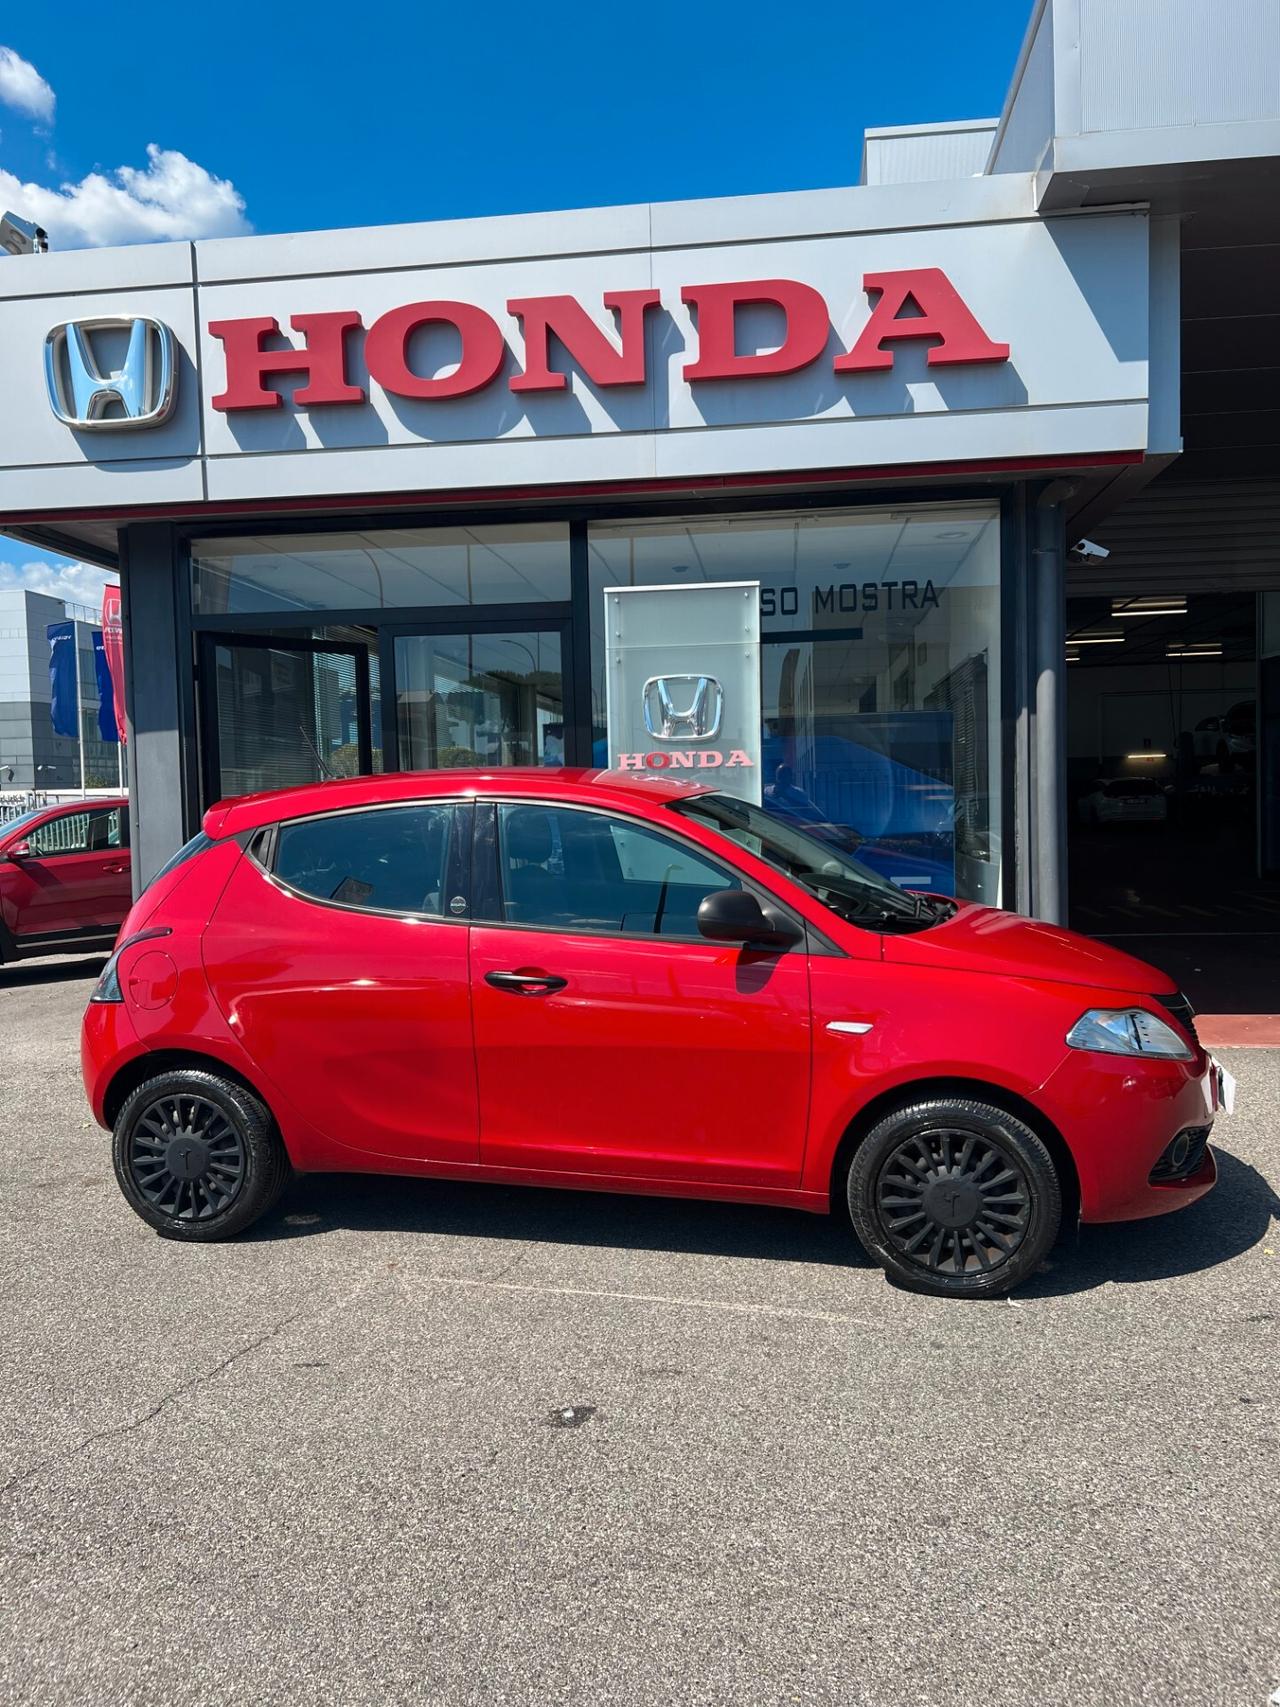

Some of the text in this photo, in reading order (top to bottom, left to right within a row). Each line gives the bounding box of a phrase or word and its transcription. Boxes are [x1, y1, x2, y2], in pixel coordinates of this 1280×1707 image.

[209, 267, 1010, 412] HONDA
[815, 579, 940, 614] MOSTRA
[617, 749, 754, 771] HONDA
